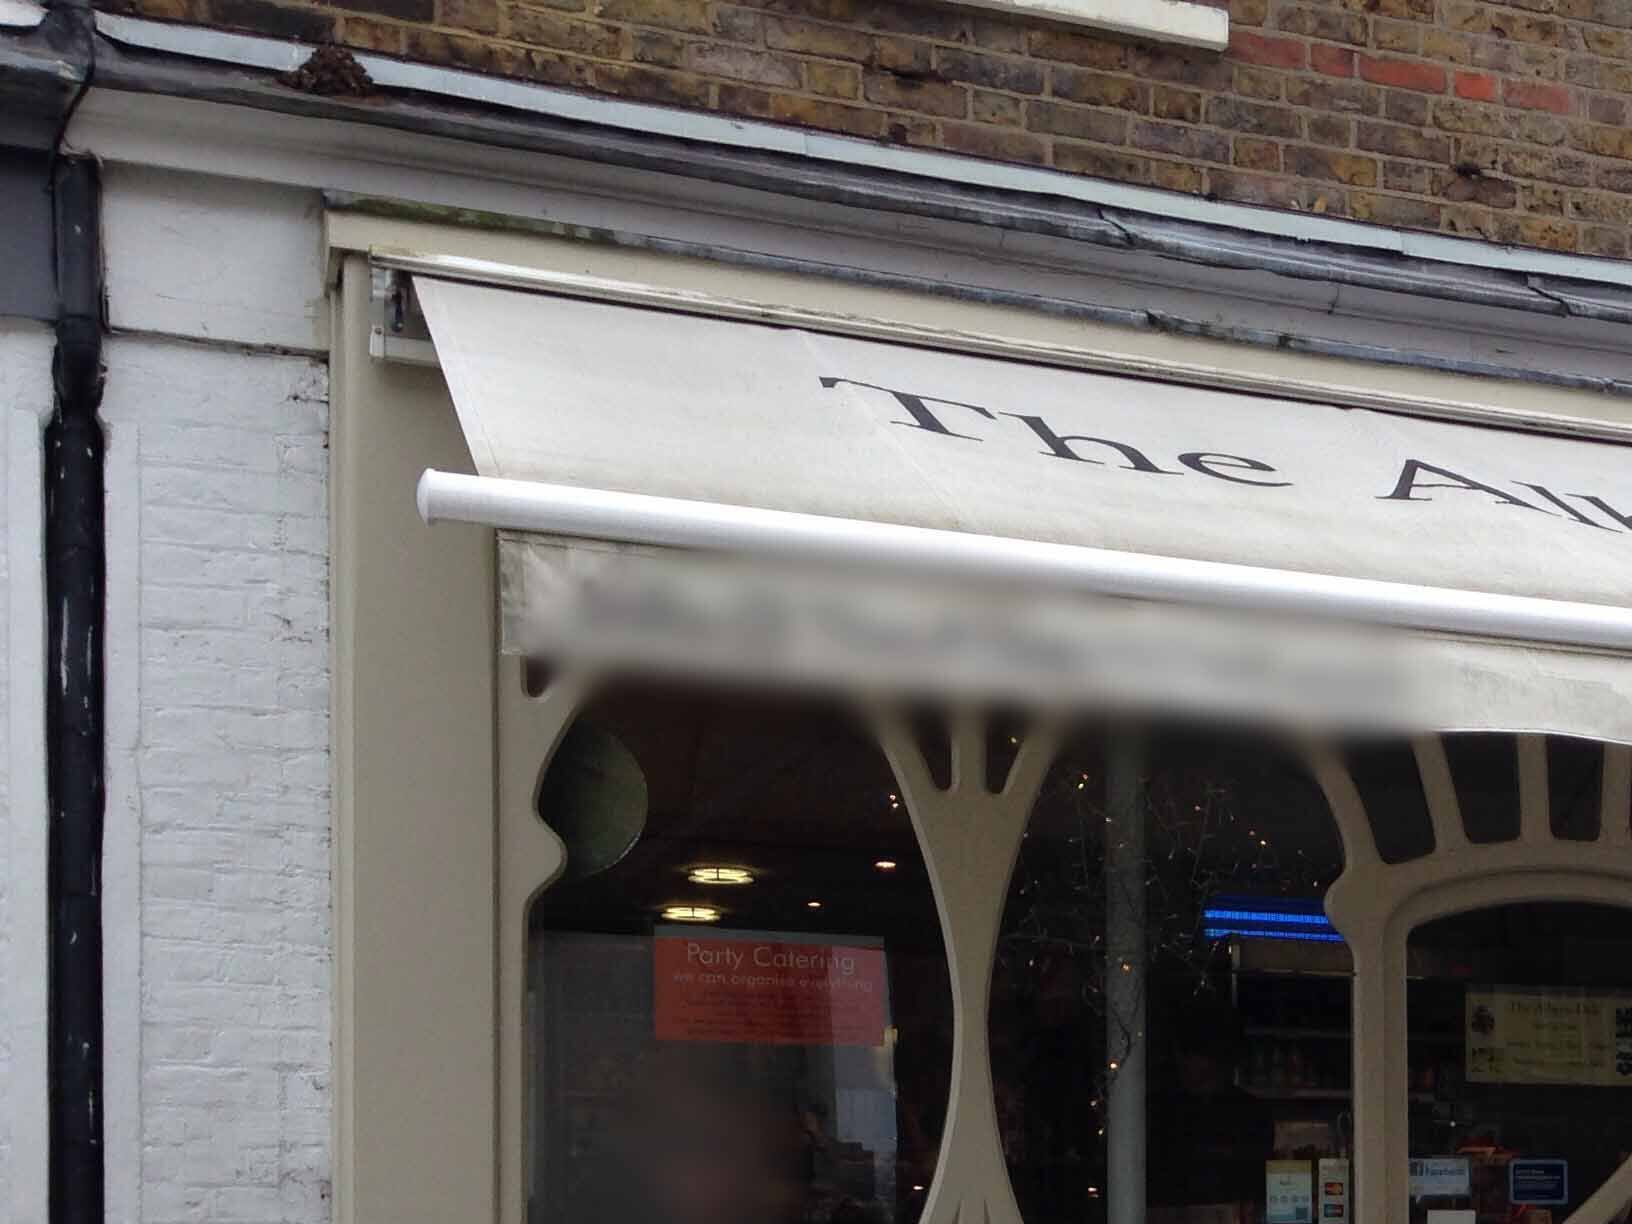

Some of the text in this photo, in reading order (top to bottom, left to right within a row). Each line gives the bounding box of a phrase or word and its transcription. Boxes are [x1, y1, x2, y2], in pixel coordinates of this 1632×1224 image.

[818, 377, 1294, 487] The
[687, 943, 854, 974] Party Catering
